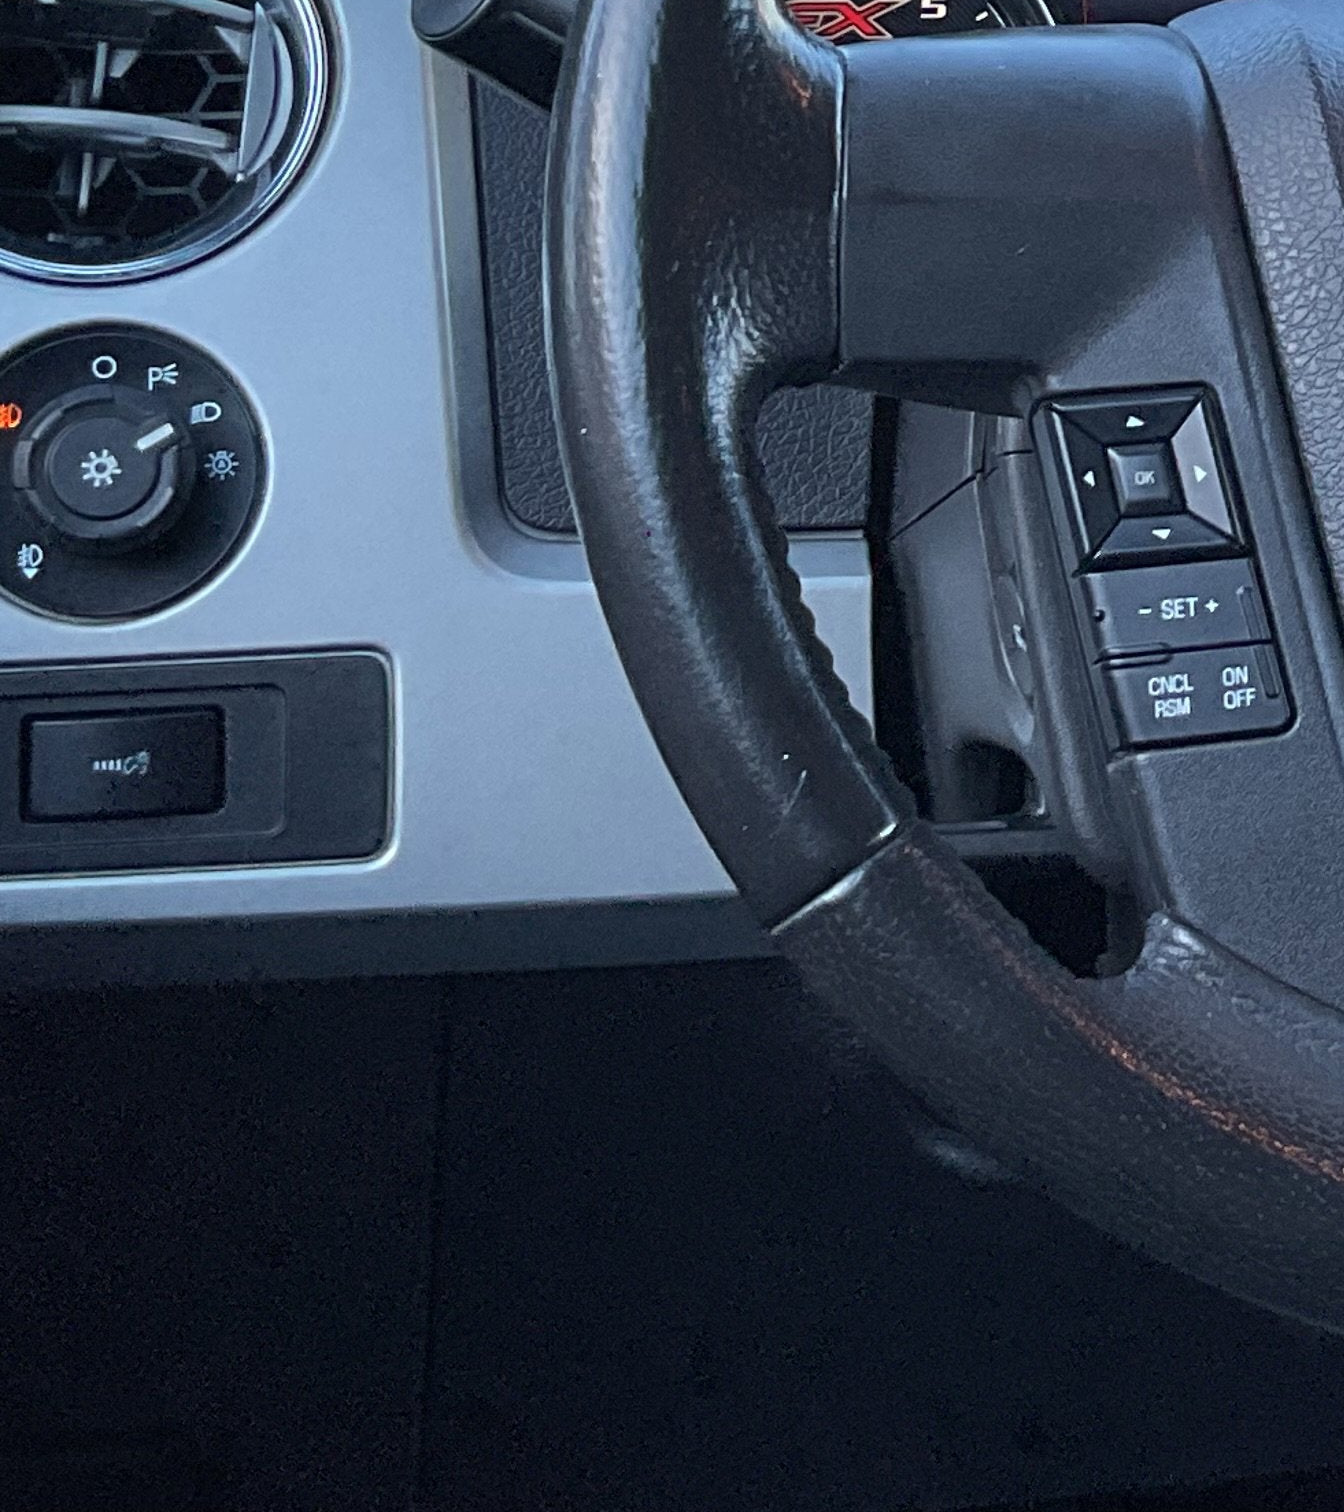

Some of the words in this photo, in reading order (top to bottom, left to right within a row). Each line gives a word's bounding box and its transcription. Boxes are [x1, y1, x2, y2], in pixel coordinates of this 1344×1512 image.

[1134, 469, 1156, 486] OK
[1160, 598, 1199, 620] SET
[1148, 674, 1194, 696] CNCL
[1222, 667, 1249, 687] ON
[1154, 696, 1192, 718] RSM
[1223, 688, 1256, 710] OFF
